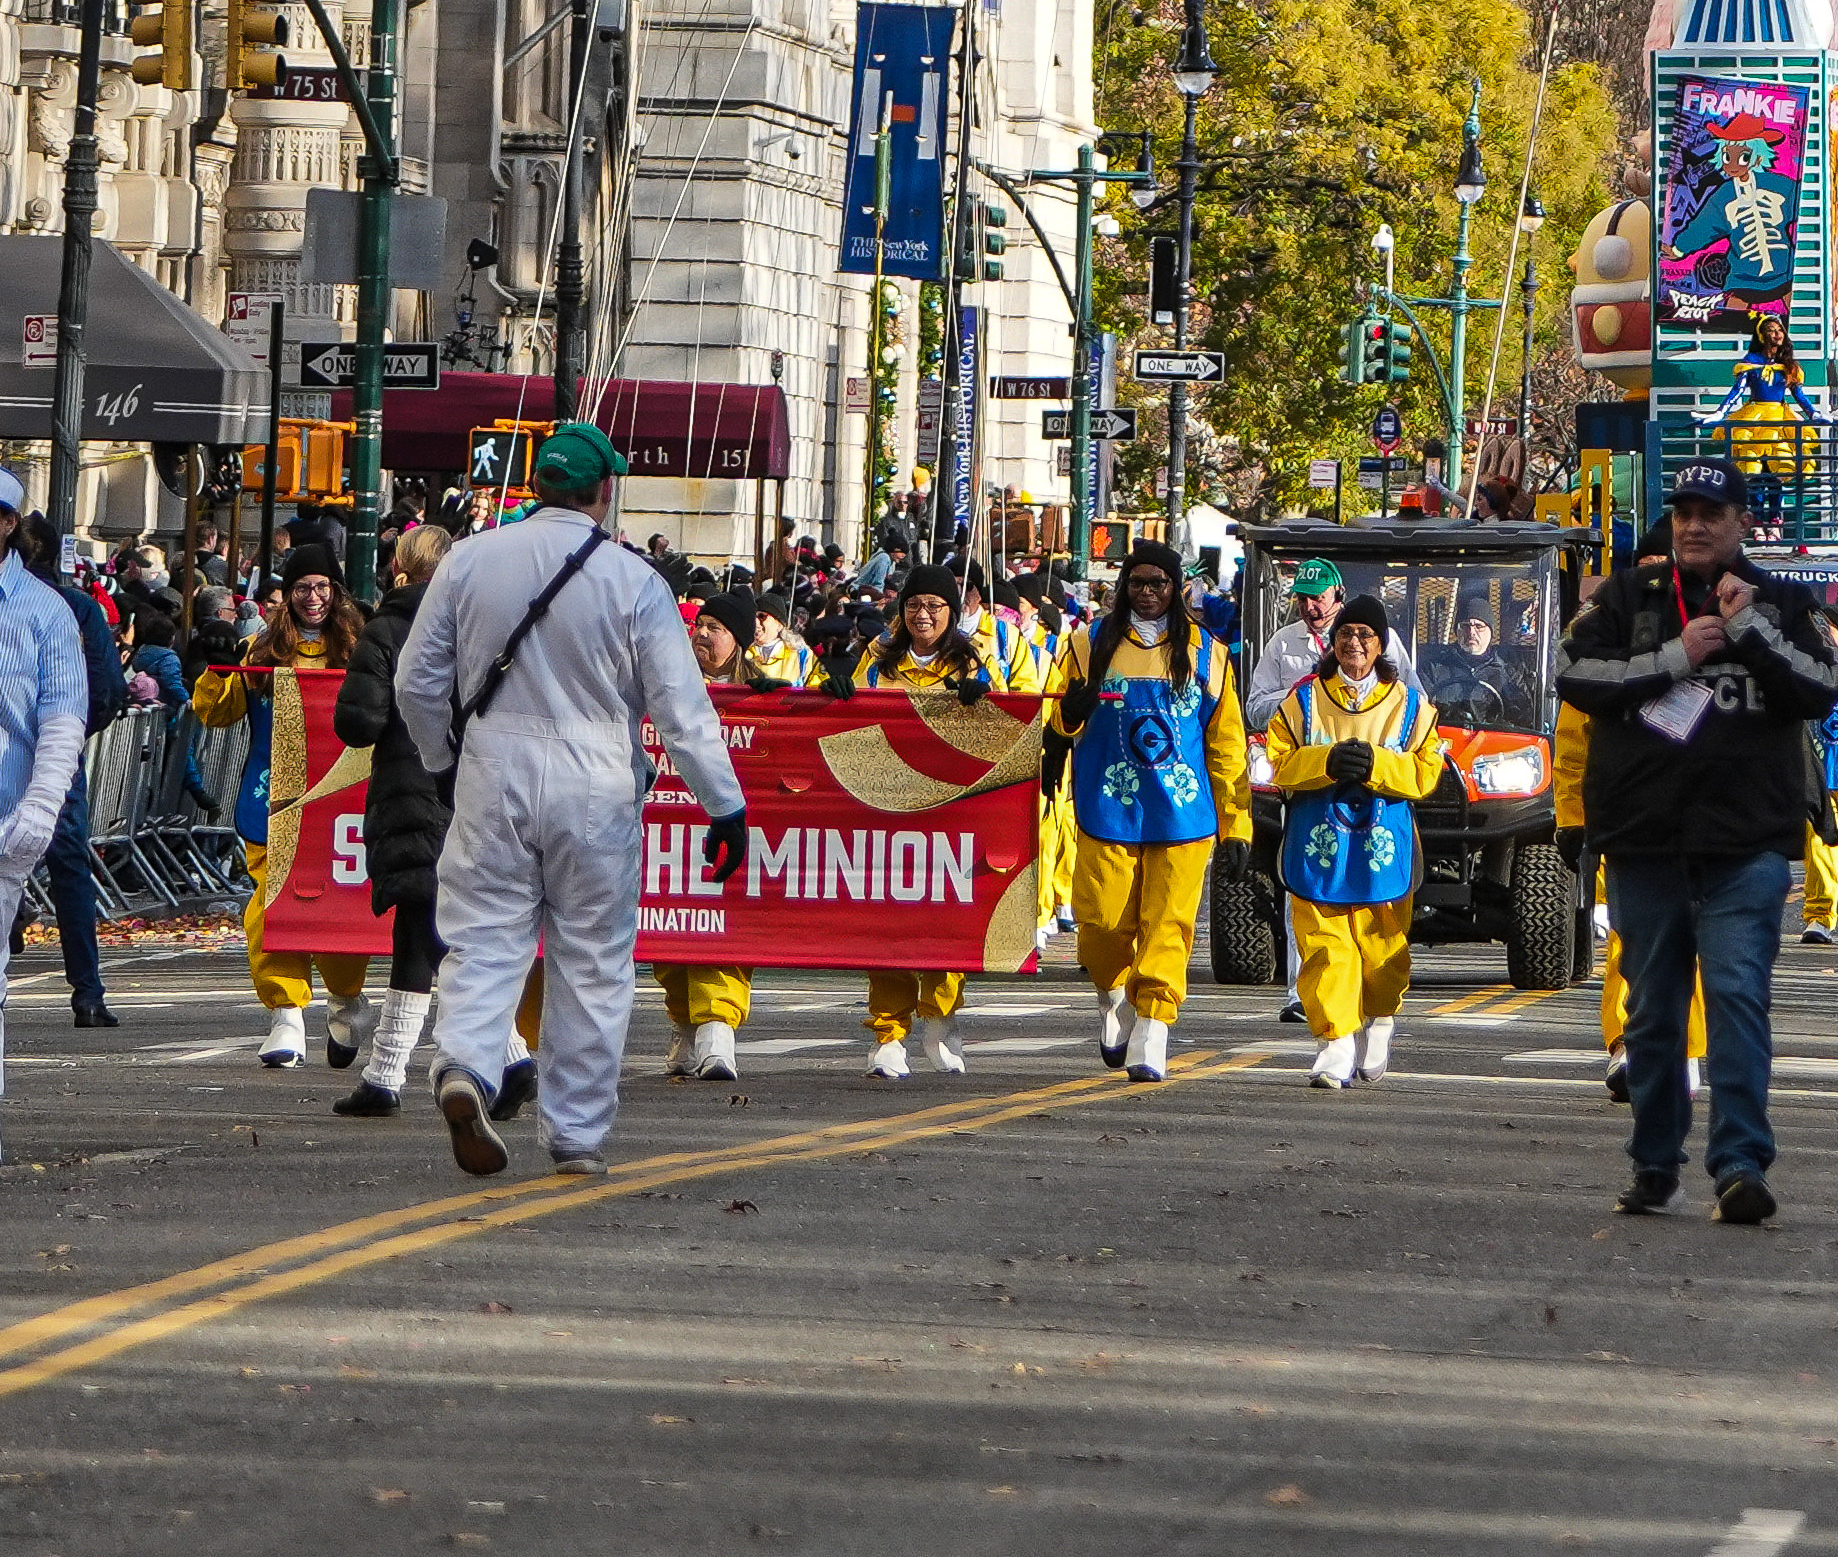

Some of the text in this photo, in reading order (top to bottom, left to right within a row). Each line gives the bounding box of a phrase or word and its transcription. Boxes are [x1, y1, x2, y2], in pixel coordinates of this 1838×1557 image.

[292, 75, 315, 98] 75
[321, 77, 338, 99] St
[1683, 84, 1797, 125] FRANKIE
[1669, 289, 1724, 309] PEACH
[1672, 306, 1710, 323] RIOT
[1148, 360, 1212, 373] ONE WAY
[1007, 382, 1051, 397] W 76 St
[95, 384, 143, 426] 146
[1674, 464, 1727, 490] NYPD
[641, 822, 975, 903] HE MINION
